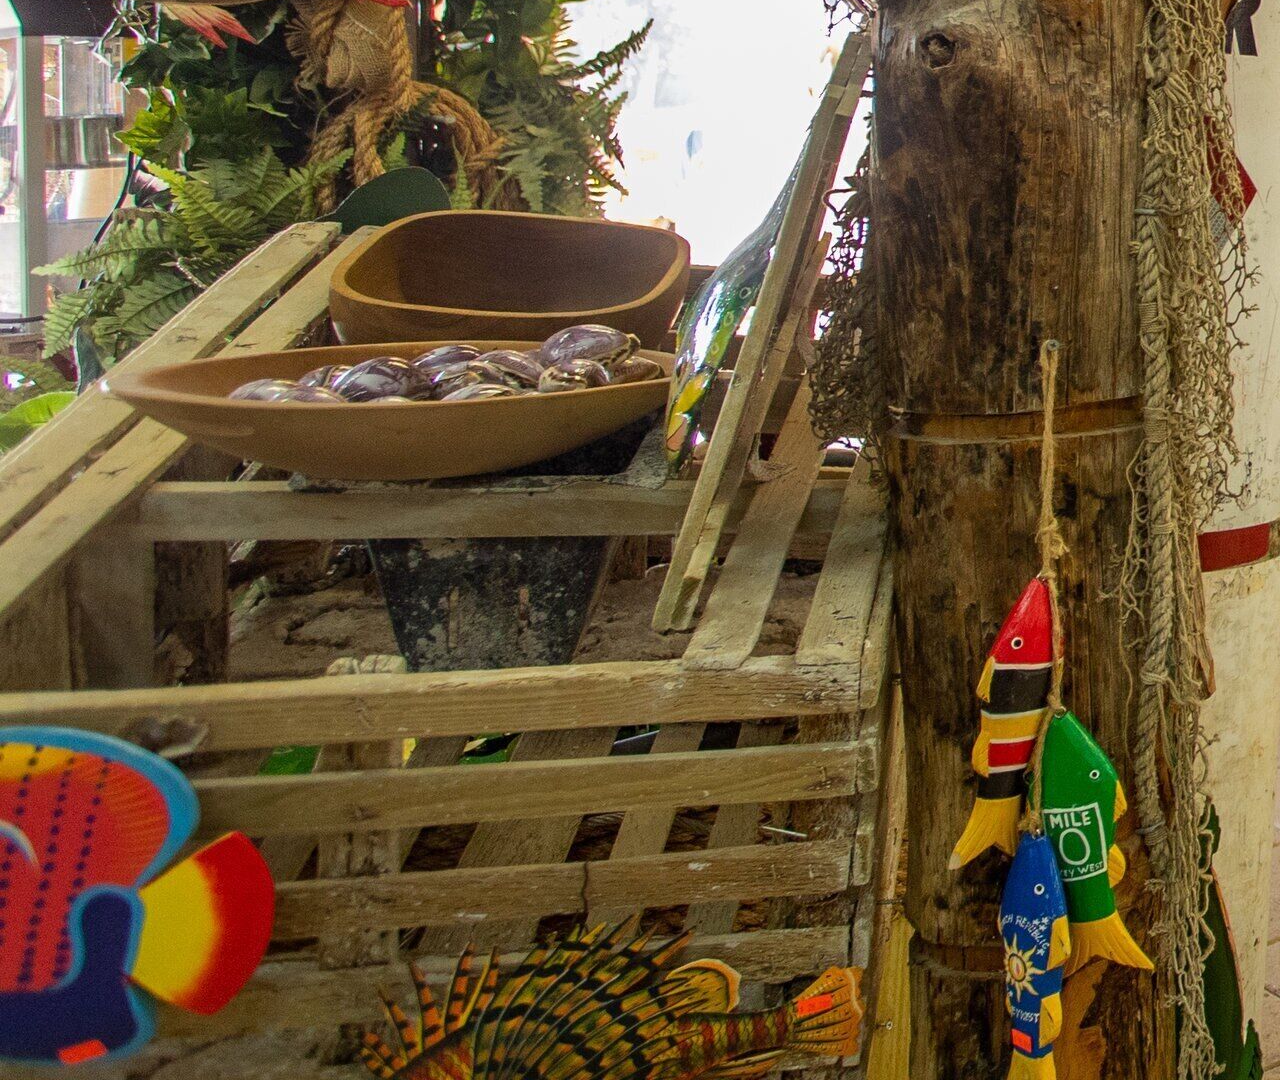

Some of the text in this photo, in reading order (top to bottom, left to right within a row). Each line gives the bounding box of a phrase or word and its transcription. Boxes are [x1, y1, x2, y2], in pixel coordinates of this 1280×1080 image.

[1049, 811, 1091, 829] MILE
[1059, 828, 1091, 866] 0
[1061, 861, 1103, 878] EY WEST
